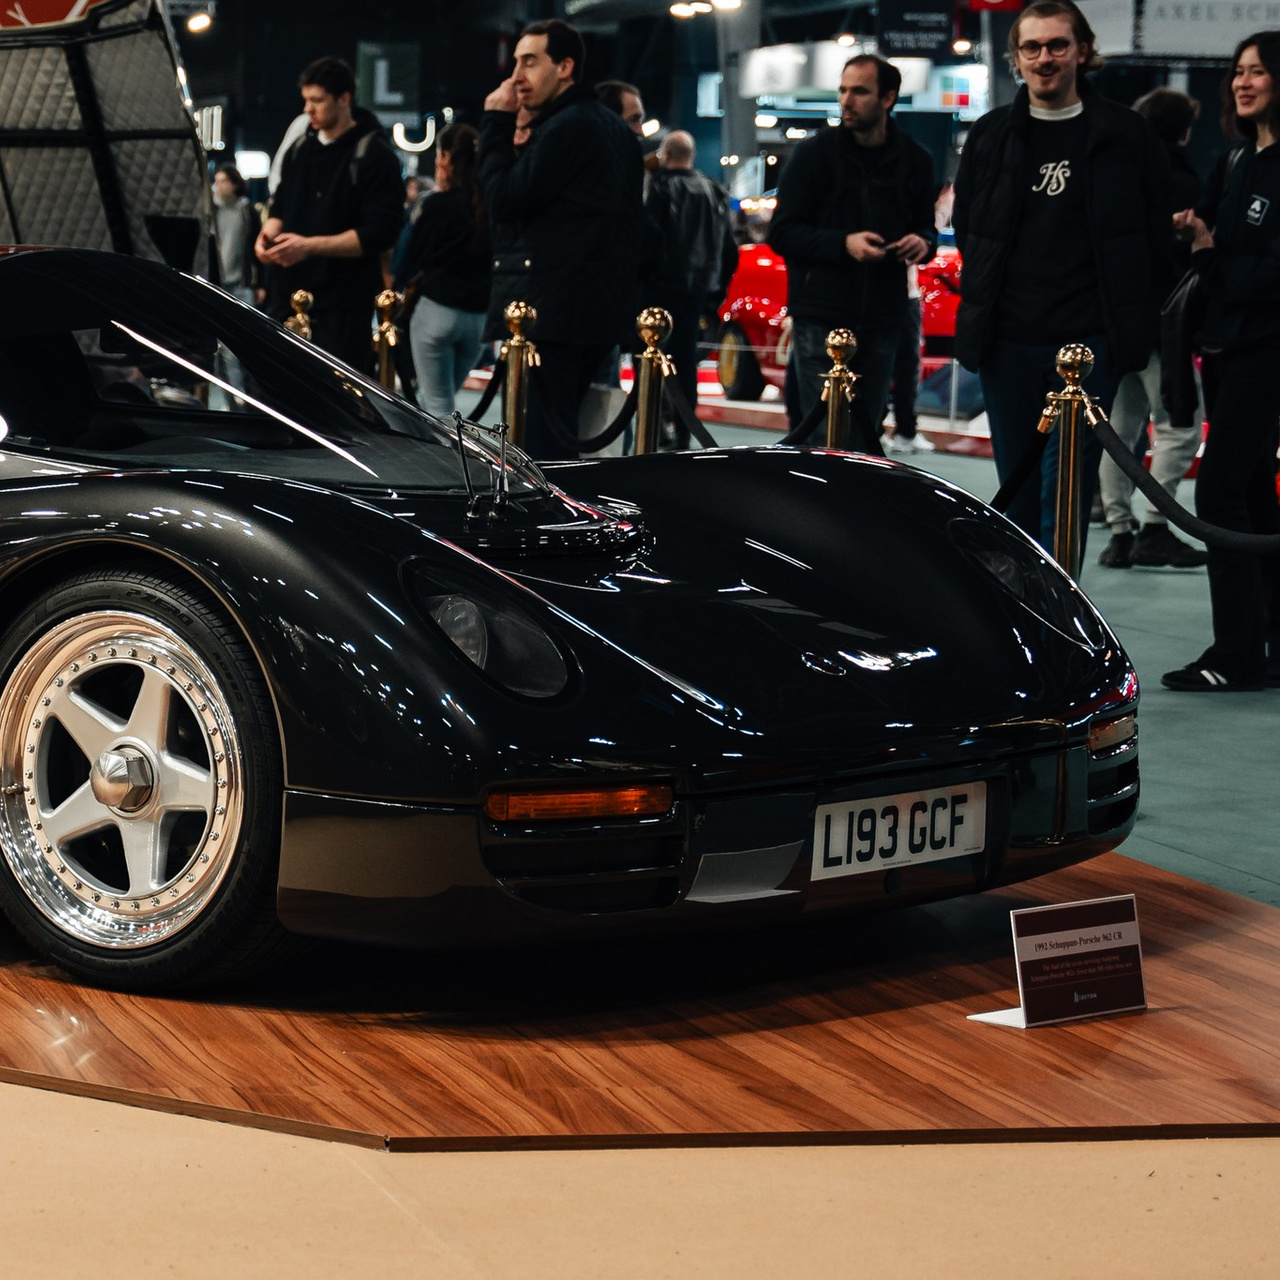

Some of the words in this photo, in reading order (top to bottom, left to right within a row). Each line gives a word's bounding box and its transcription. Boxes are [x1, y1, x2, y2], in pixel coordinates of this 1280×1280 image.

[823, 806, 899, 868] L193
[908, 794, 968, 854] GCF
[1034, 942, 1048, 952] 1992
